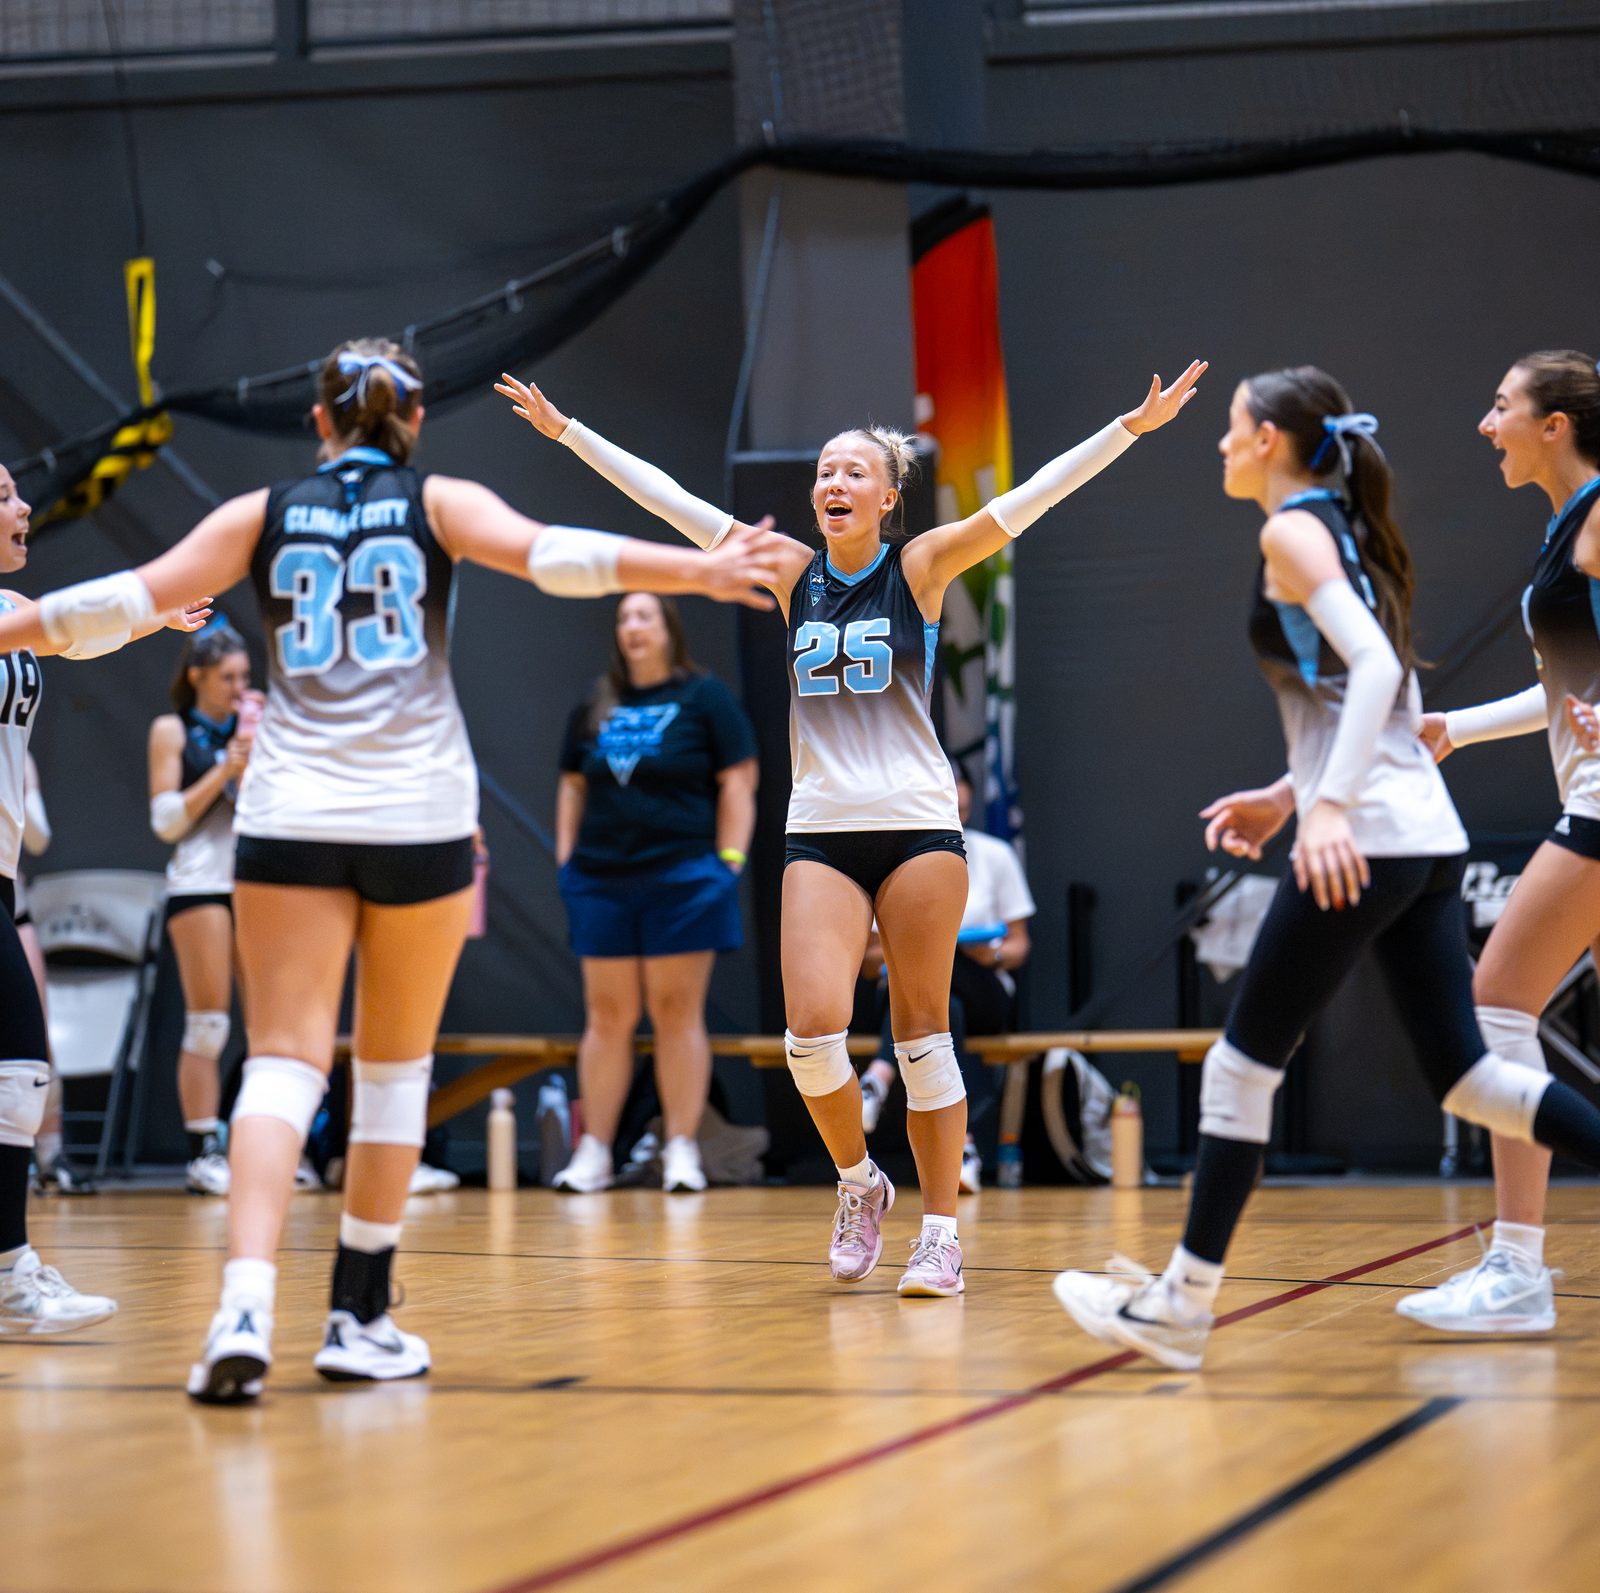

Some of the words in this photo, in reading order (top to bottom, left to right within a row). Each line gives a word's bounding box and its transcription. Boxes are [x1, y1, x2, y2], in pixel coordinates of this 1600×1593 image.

[361, 497, 409, 531] CITY
[269, 535, 428, 677] 33
[793, 617, 893, 697] 25
